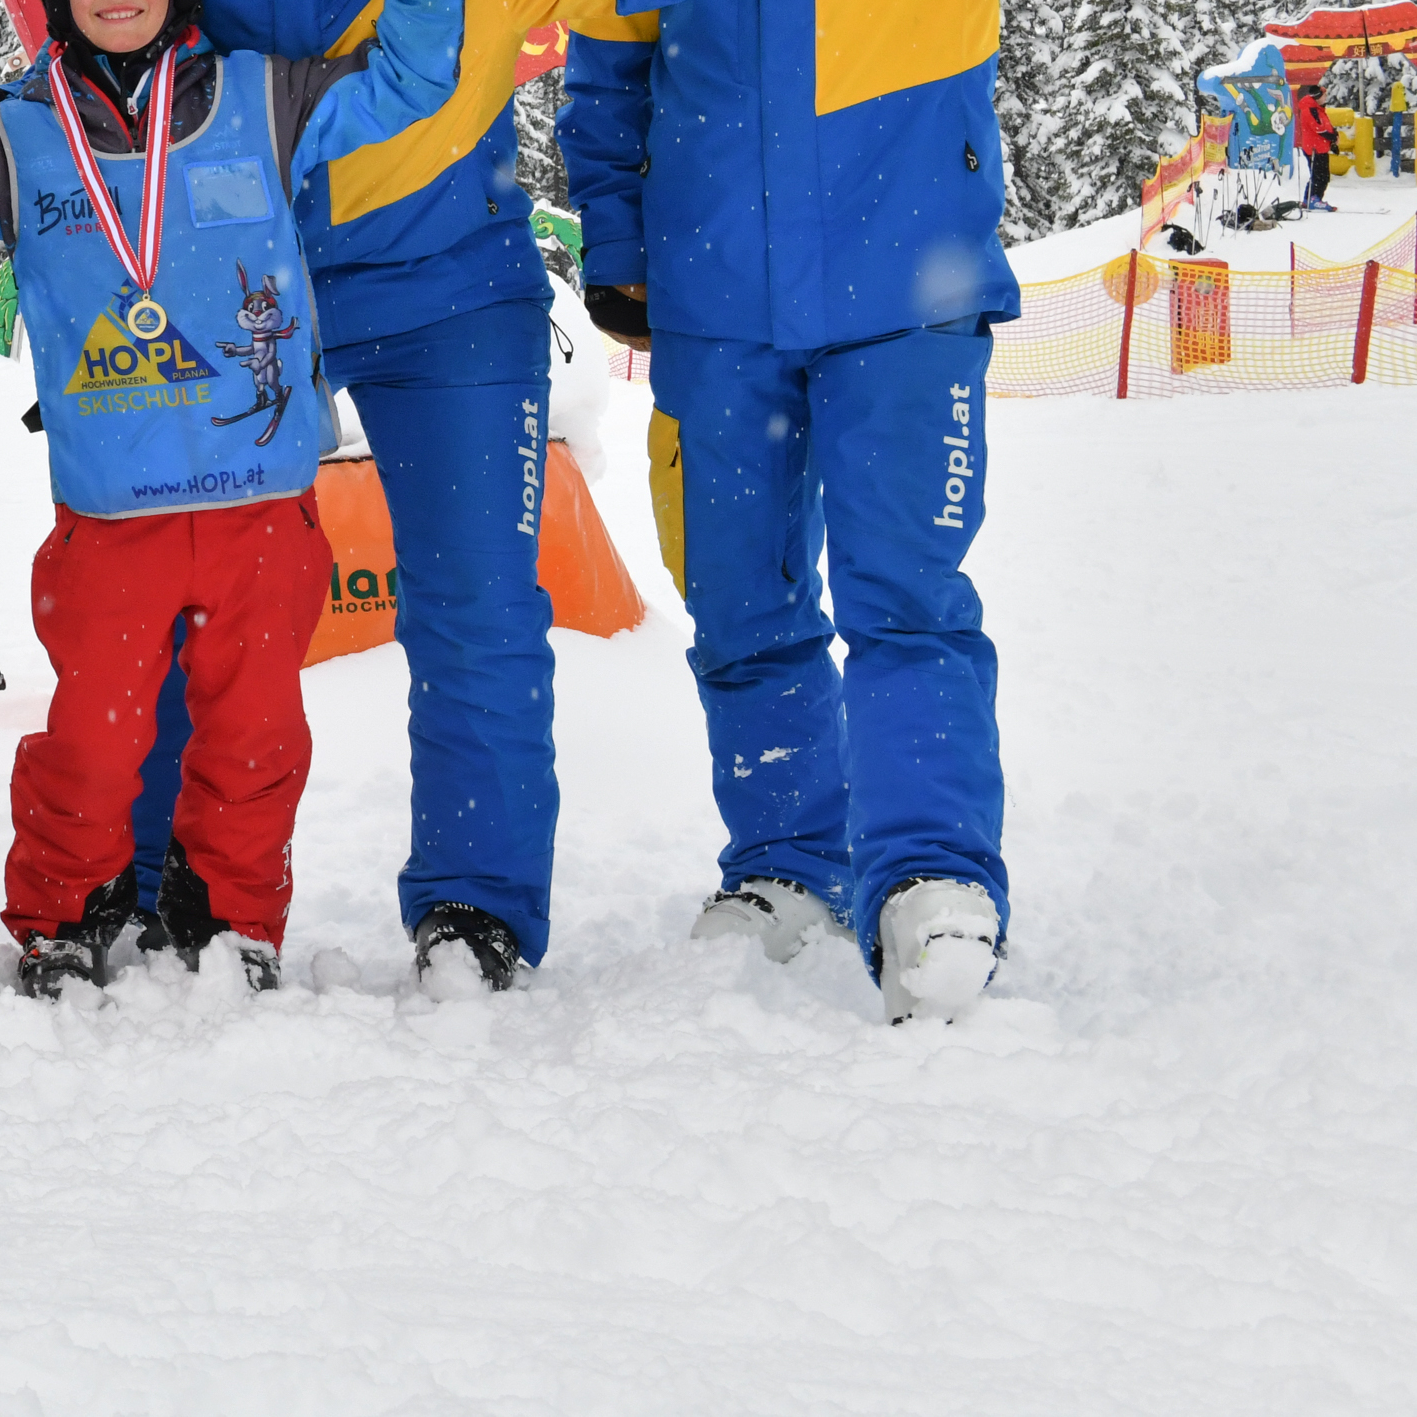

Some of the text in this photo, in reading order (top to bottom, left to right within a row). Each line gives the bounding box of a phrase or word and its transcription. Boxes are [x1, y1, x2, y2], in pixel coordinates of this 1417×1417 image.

[65, 222, 105, 236] SPOR
[83, 339, 198, 379] HOPL
[172, 369, 209, 381] PLANAI
[78, 384, 212, 417] SKISCHULE
[81, 376, 148, 390] HOCHWURZEN
[515, 398, 540, 537] hopl.at
[934, 382, 971, 530] hopl.at
[131, 462, 265, 499] www.HOPL.at
